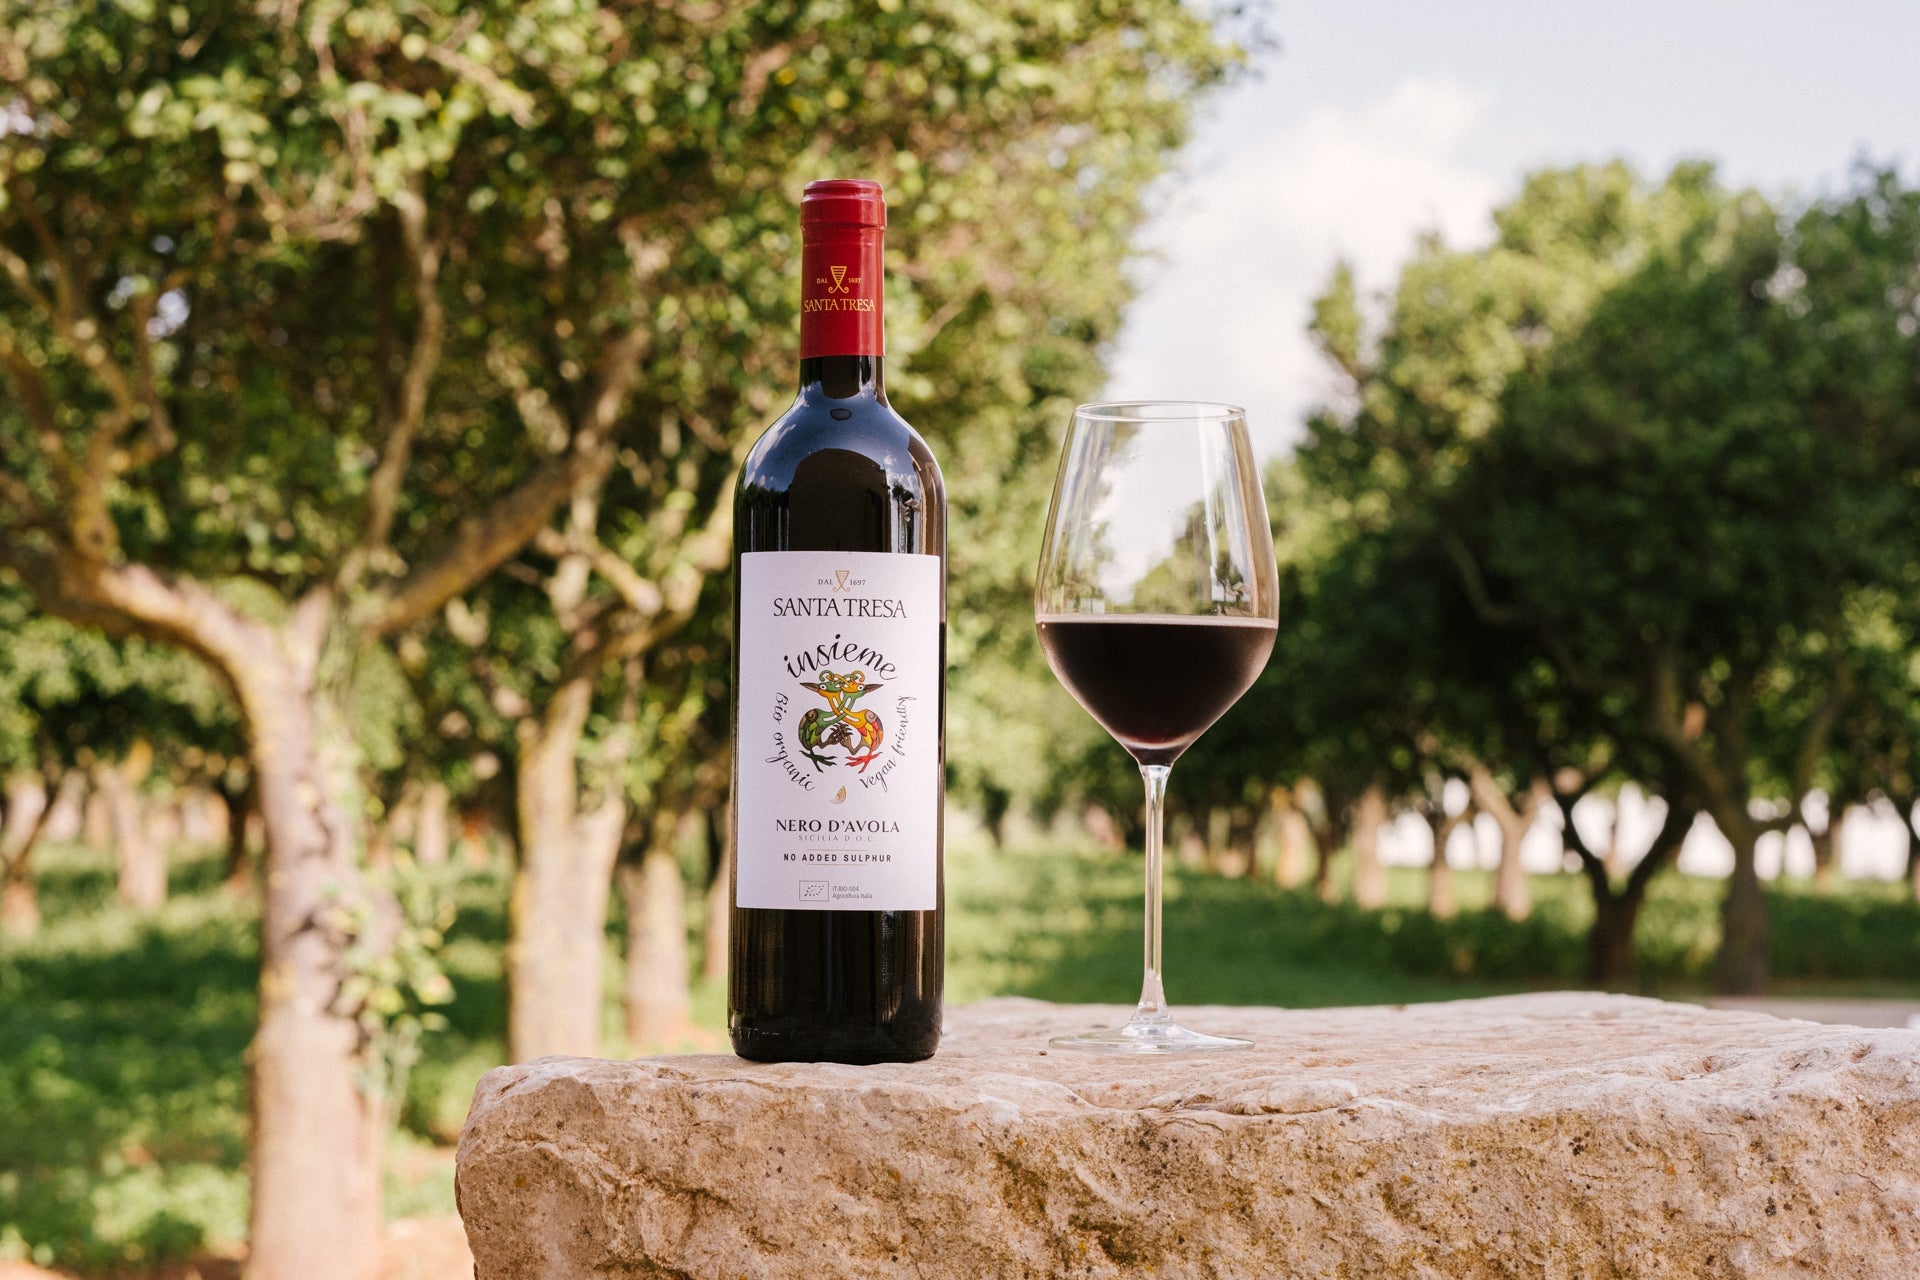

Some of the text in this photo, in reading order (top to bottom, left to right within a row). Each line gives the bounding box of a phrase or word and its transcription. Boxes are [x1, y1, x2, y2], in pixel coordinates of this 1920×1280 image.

[804, 298, 876, 312] SANTA TRESA
[773, 598, 907, 618] SANTA TRESA
[784, 633, 898, 680] insieme
[891, 695, 917, 756] friendly
[765, 692, 815, 792] Bio organic
[776, 819, 822, 832] NERO
[783, 853, 892, 862] NO ADDED SULPHUR
